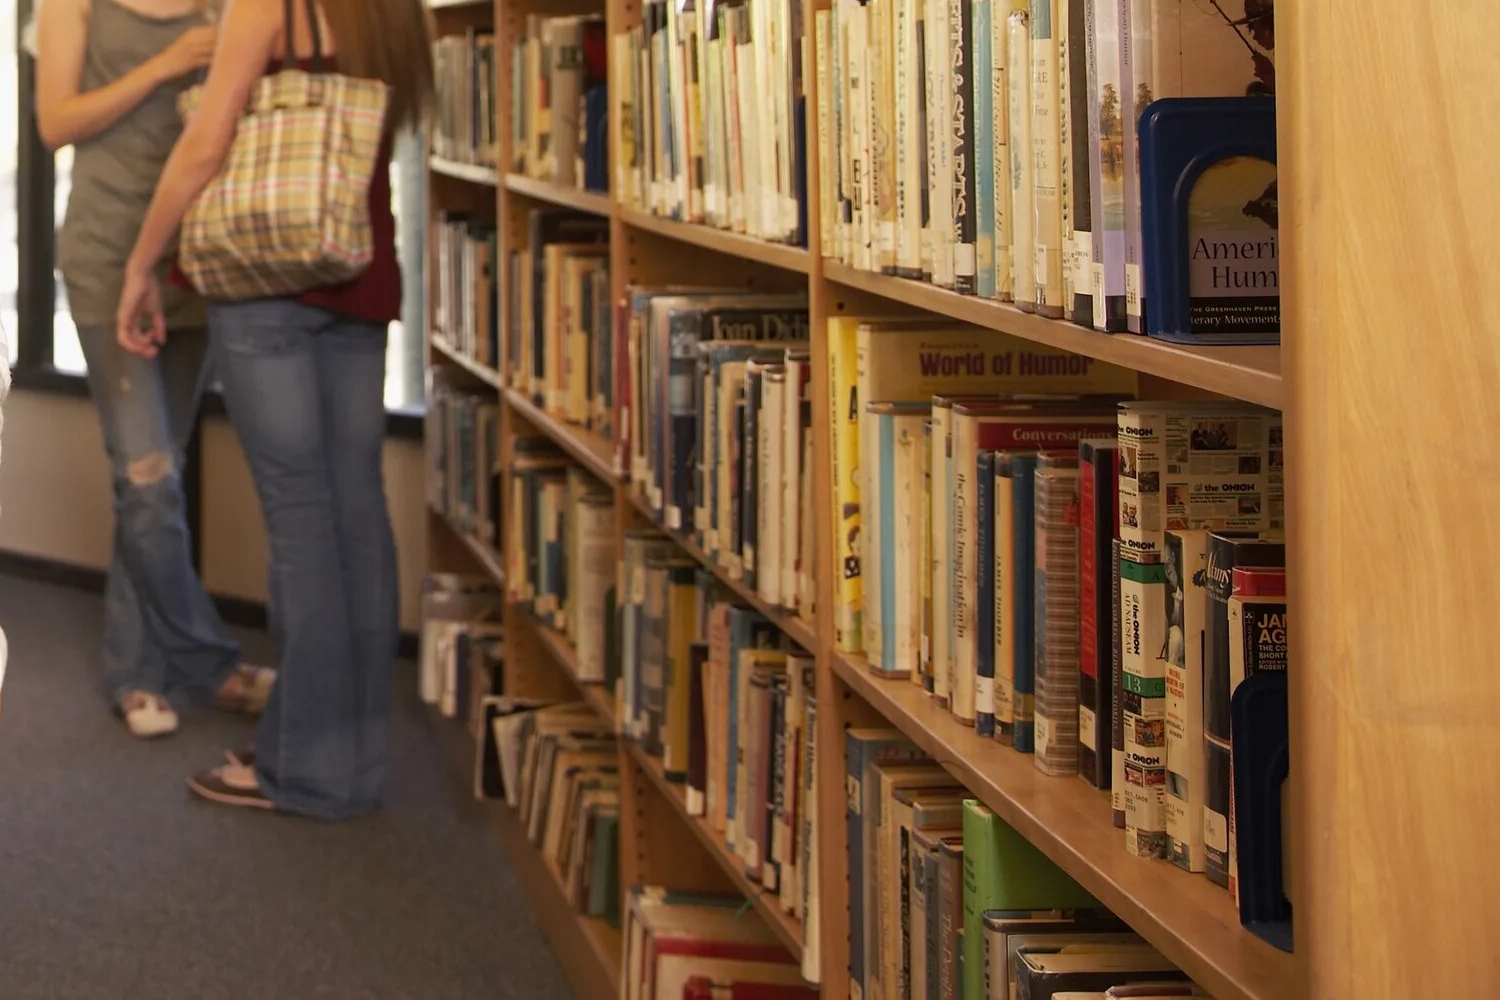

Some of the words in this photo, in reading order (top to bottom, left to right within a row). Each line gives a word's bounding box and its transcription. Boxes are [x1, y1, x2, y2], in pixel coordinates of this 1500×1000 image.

[952, 94, 966, 216] STARTS
[1193, 237, 1279, 260] Ameri
[1212, 266, 1278, 288] Hum
[919, 351, 985, 377] World
[992, 350, 1014, 376] of
[1018, 351, 1094, 376] Humor
[1012, 428, 1113, 442] Conversations
[1125, 426, 1153, 437] ONION
[1204, 484, 1219, 492] the
[1222, 483, 1255, 492] ONION
[957, 496, 967, 538] Comic
[1128, 539, 1155, 550] ONION
[953, 541, 967, 623] Imagination
[1133, 620, 1141, 656] ONION
[1258, 629, 1286, 644] AG
[1125, 675, 1141, 693] 13
[1132, 753, 1160, 765] ONION
